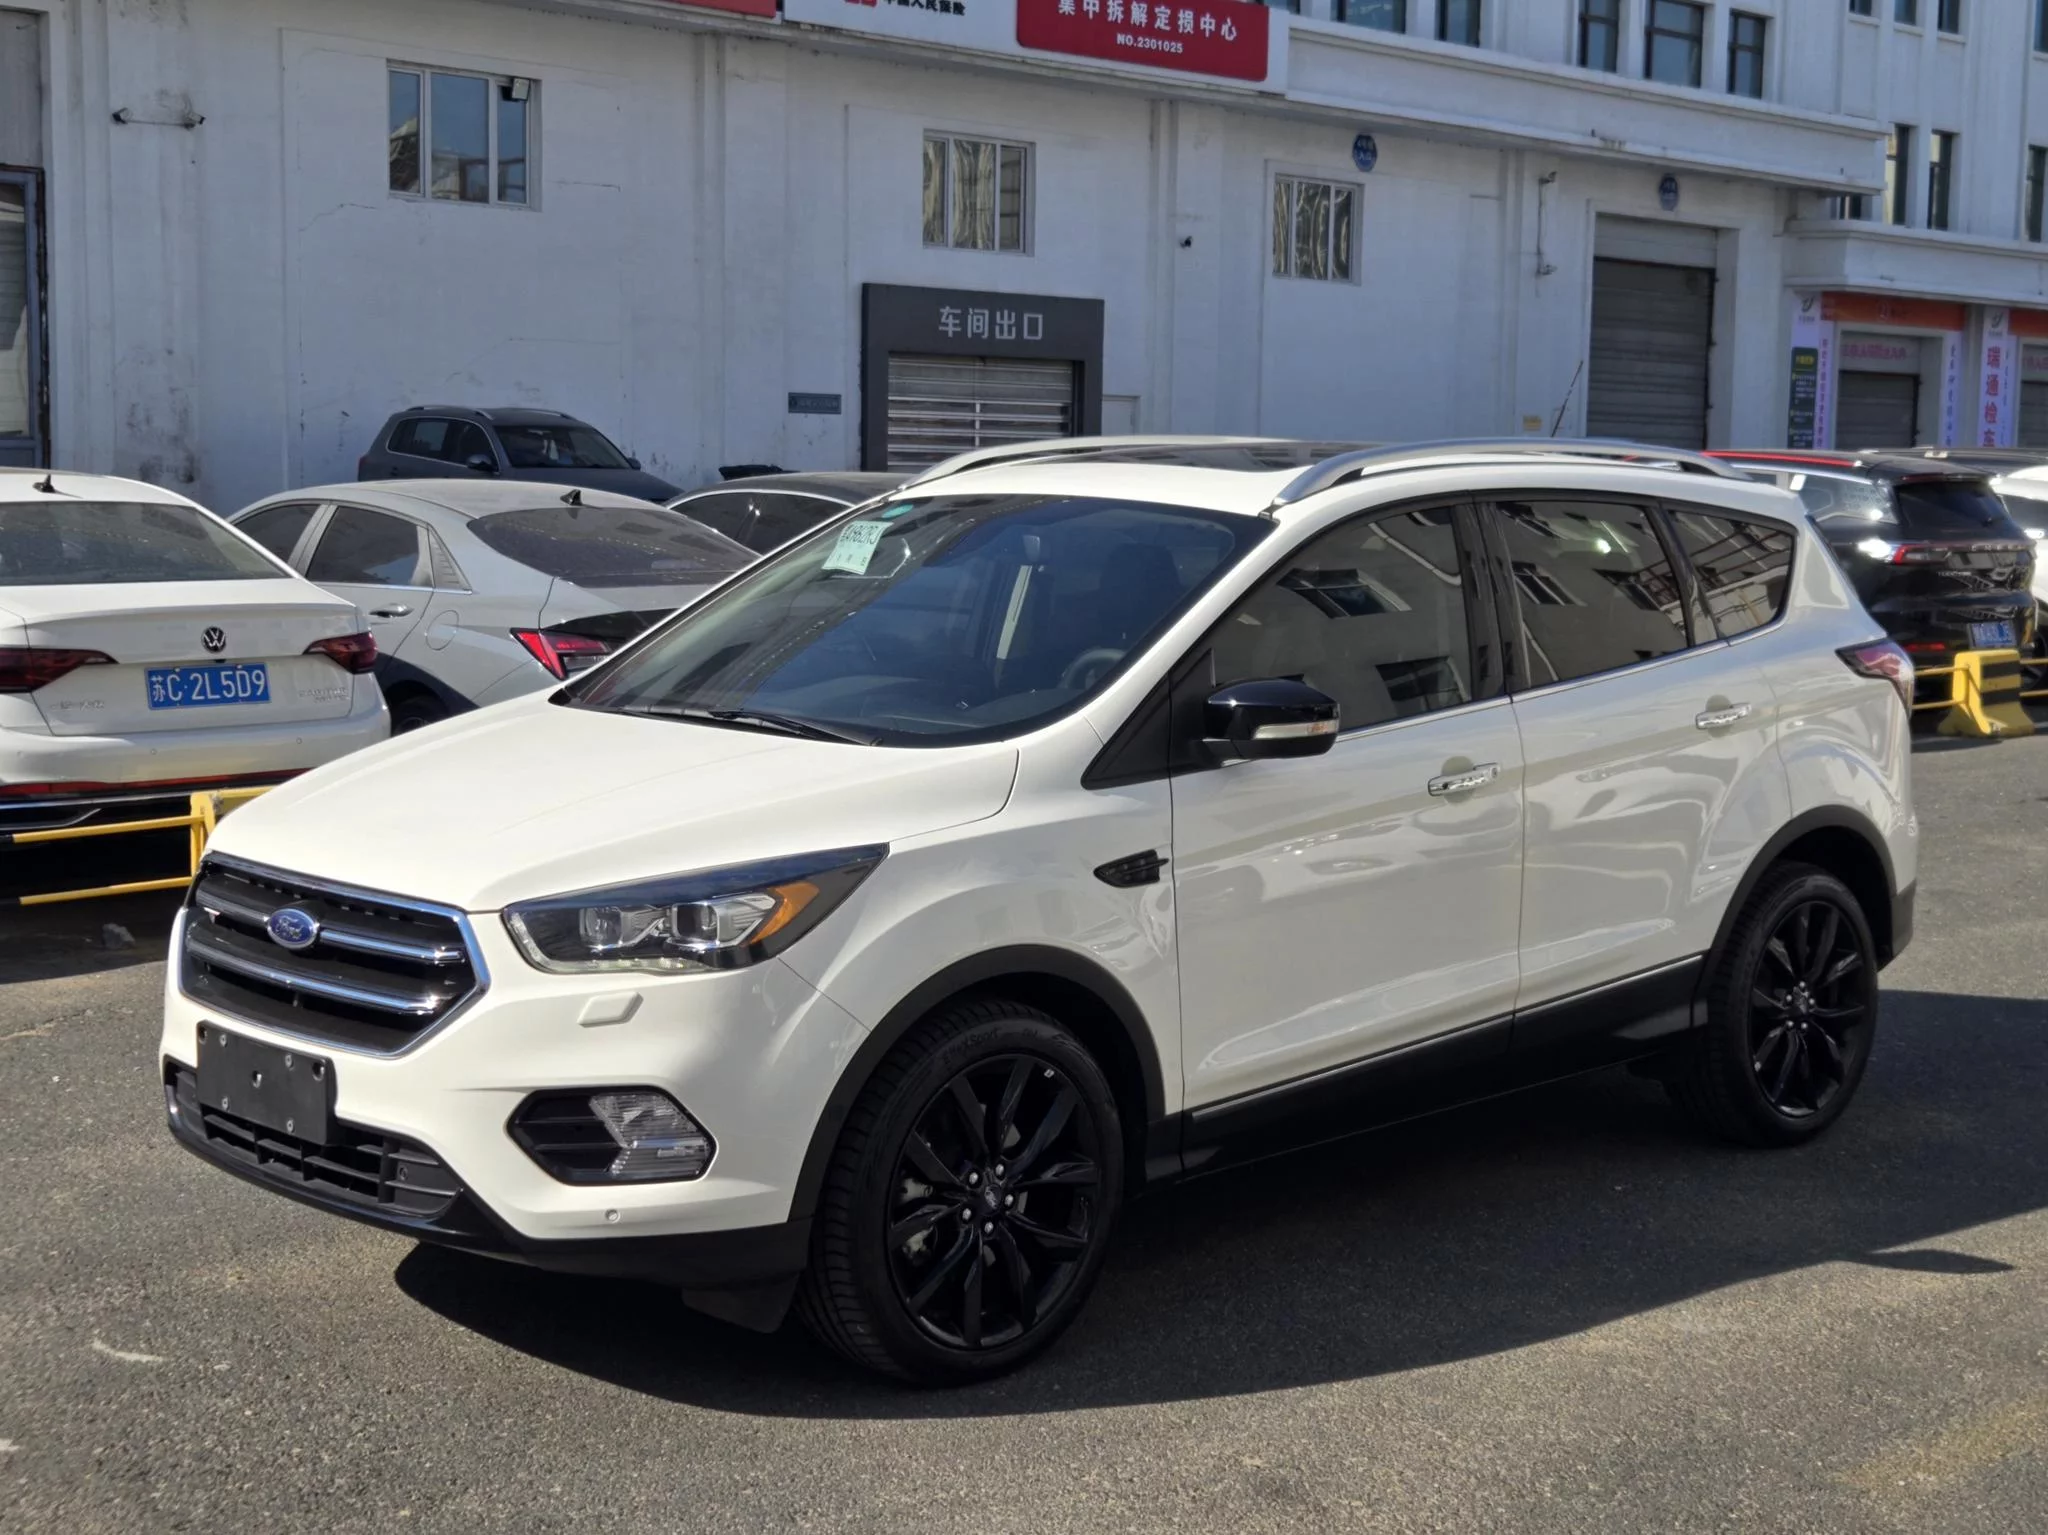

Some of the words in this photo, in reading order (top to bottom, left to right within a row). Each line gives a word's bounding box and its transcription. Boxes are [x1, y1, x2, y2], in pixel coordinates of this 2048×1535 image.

[1116, 33, 1184, 54] NO.2301025
[938, 306, 1044, 340] 车间出口
